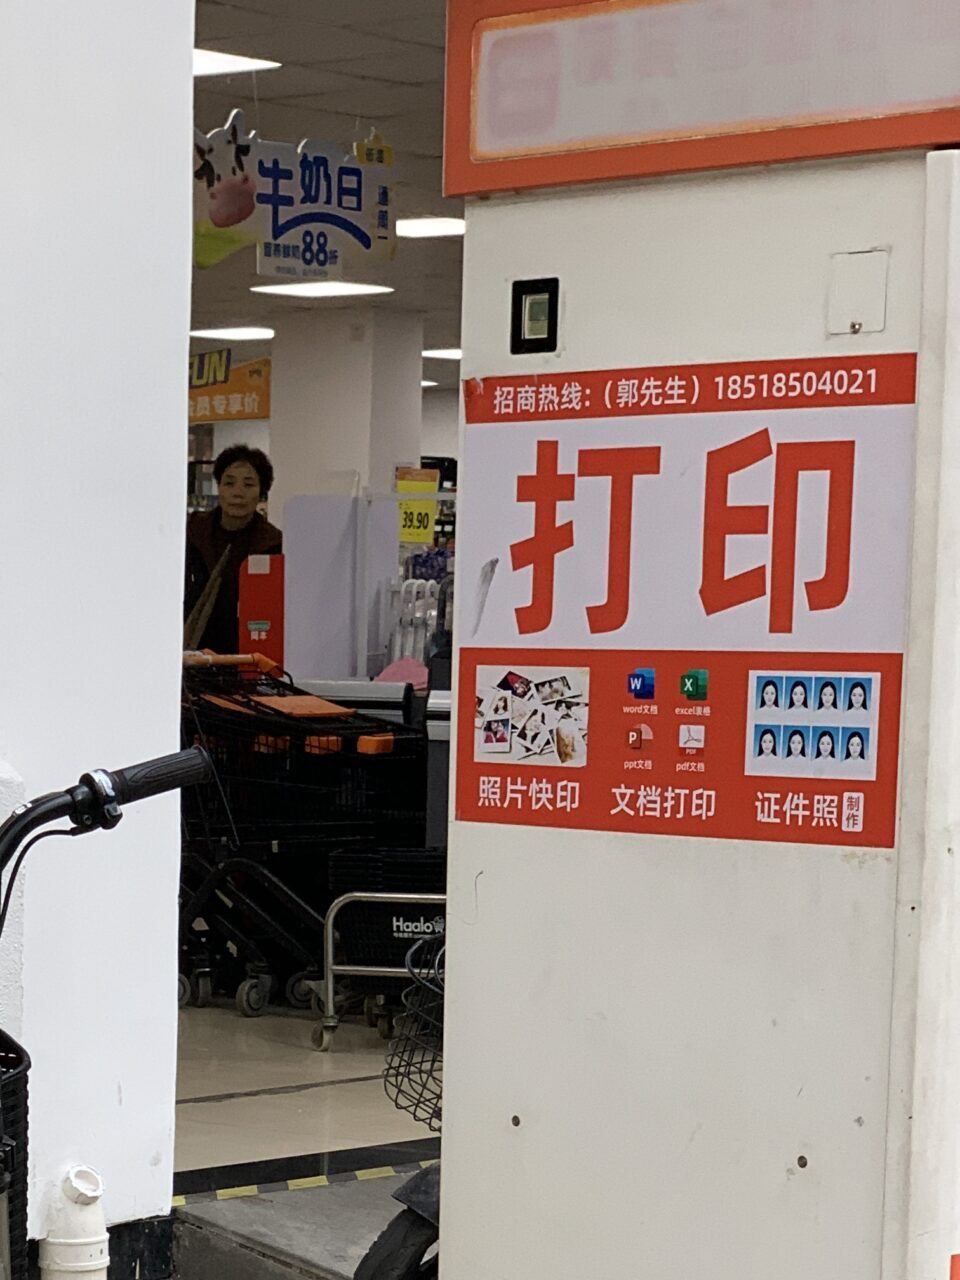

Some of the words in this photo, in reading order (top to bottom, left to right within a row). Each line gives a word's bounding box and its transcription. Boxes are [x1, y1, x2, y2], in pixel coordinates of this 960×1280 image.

[256, 152, 366, 232] 牛奶日
[714, 368, 878, 401] 18518504021
[402, 511, 430, 530] 39.90
[509, 427, 856, 635] 打印
[623, 704, 658, 715] word文档
[624, 760, 652, 770] ppt文档
[676, 762, 705, 772] pdf文档
[477, 775, 580, 813] 照片快印
[610, 783, 716, 820] 文档打印
[755, 791, 839, 828] 证件照
[845, 795, 861, 829] 制作
[392, 916, 433, 933] Haalo
